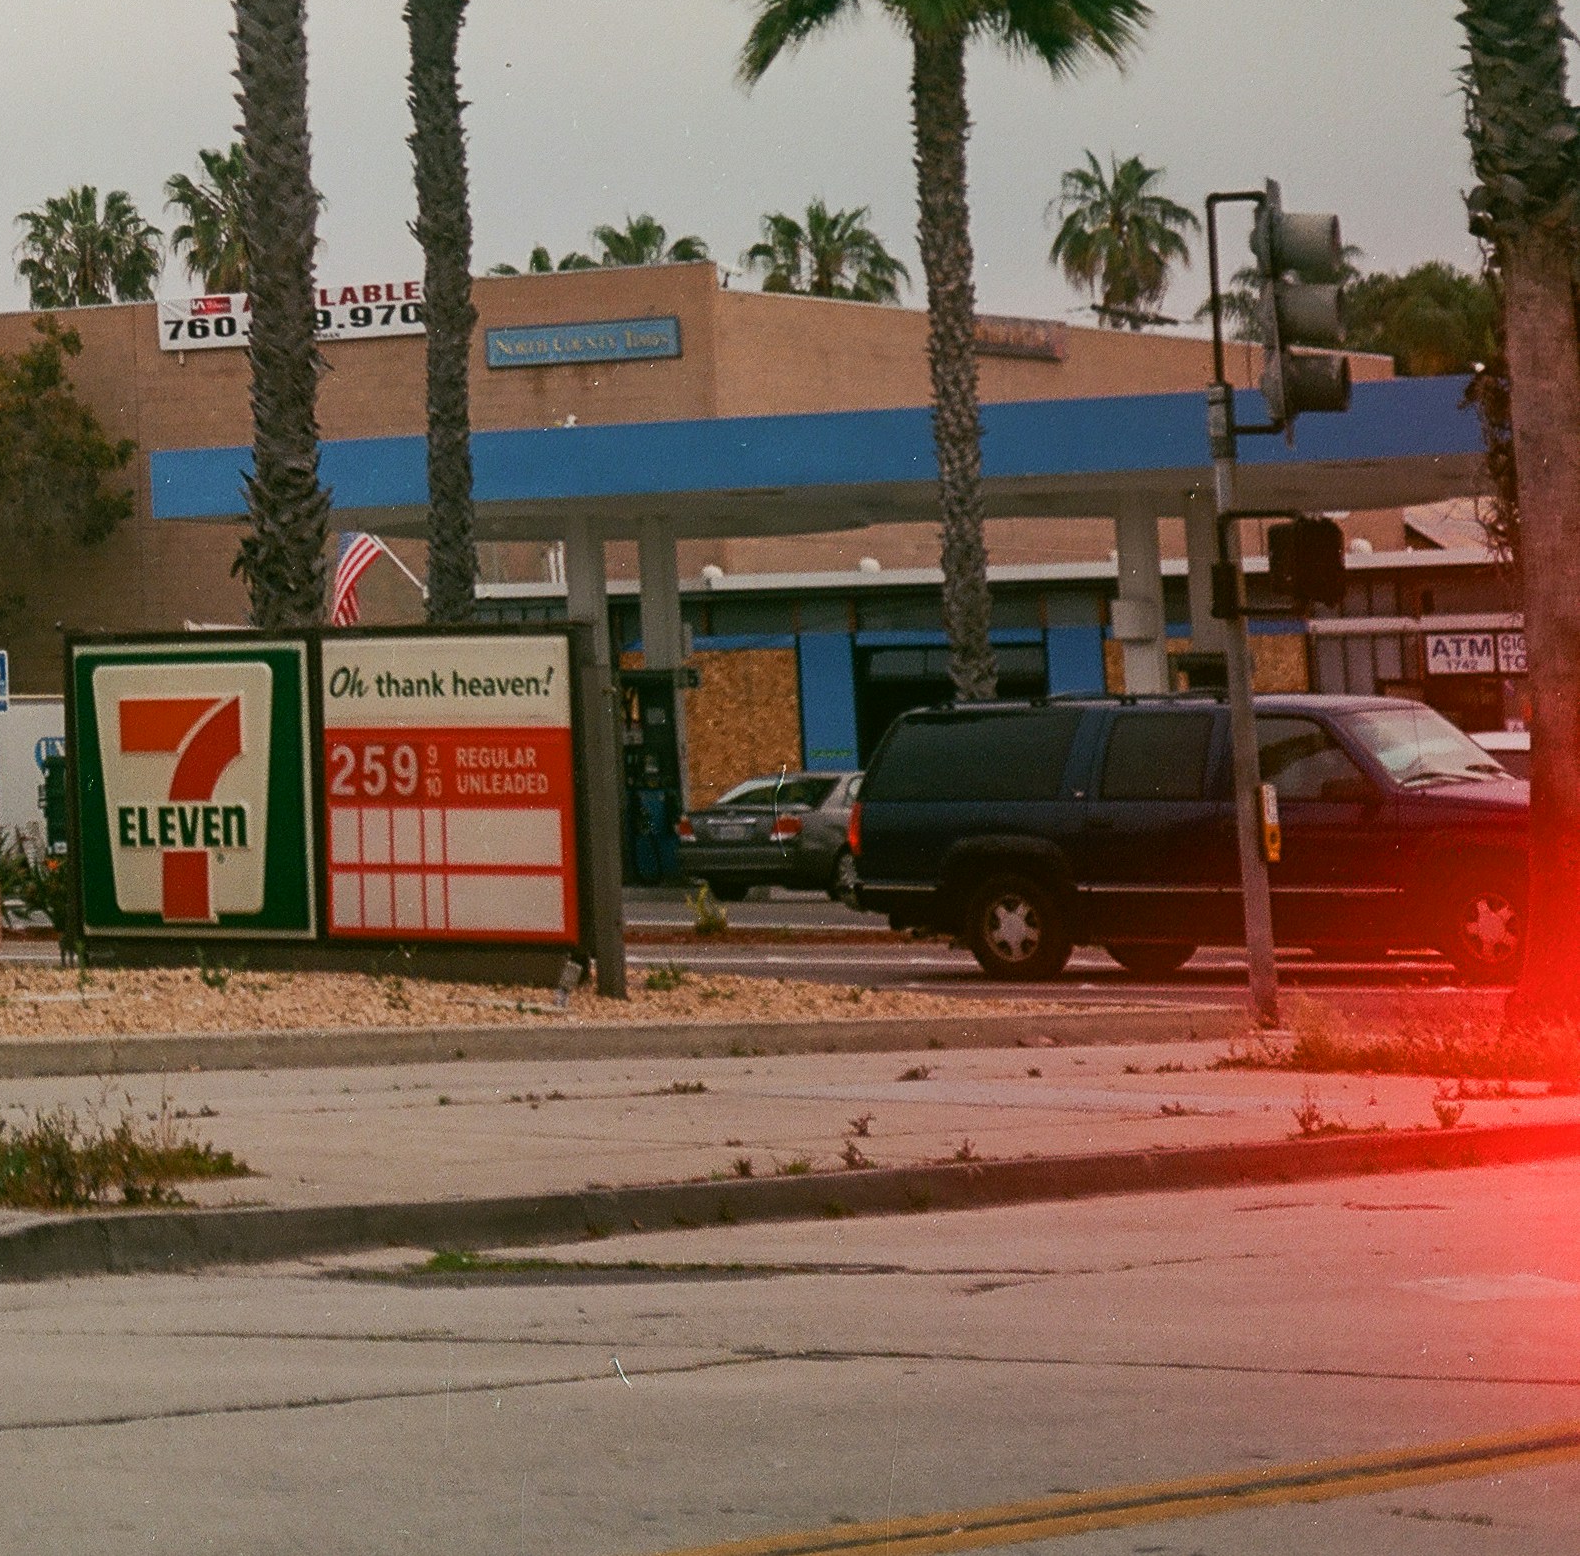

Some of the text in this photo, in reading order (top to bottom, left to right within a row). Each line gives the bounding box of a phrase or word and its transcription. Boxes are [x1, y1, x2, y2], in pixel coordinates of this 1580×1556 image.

[1432, 638, 1491, 657] ATM
[329, 666, 554, 698] Oh thank heaven!
[330, 744, 418, 796] 259
[456, 747, 537, 768] REGULAR
[456, 774, 548, 795] UNLEADED
[119, 695, 242, 919] 7
